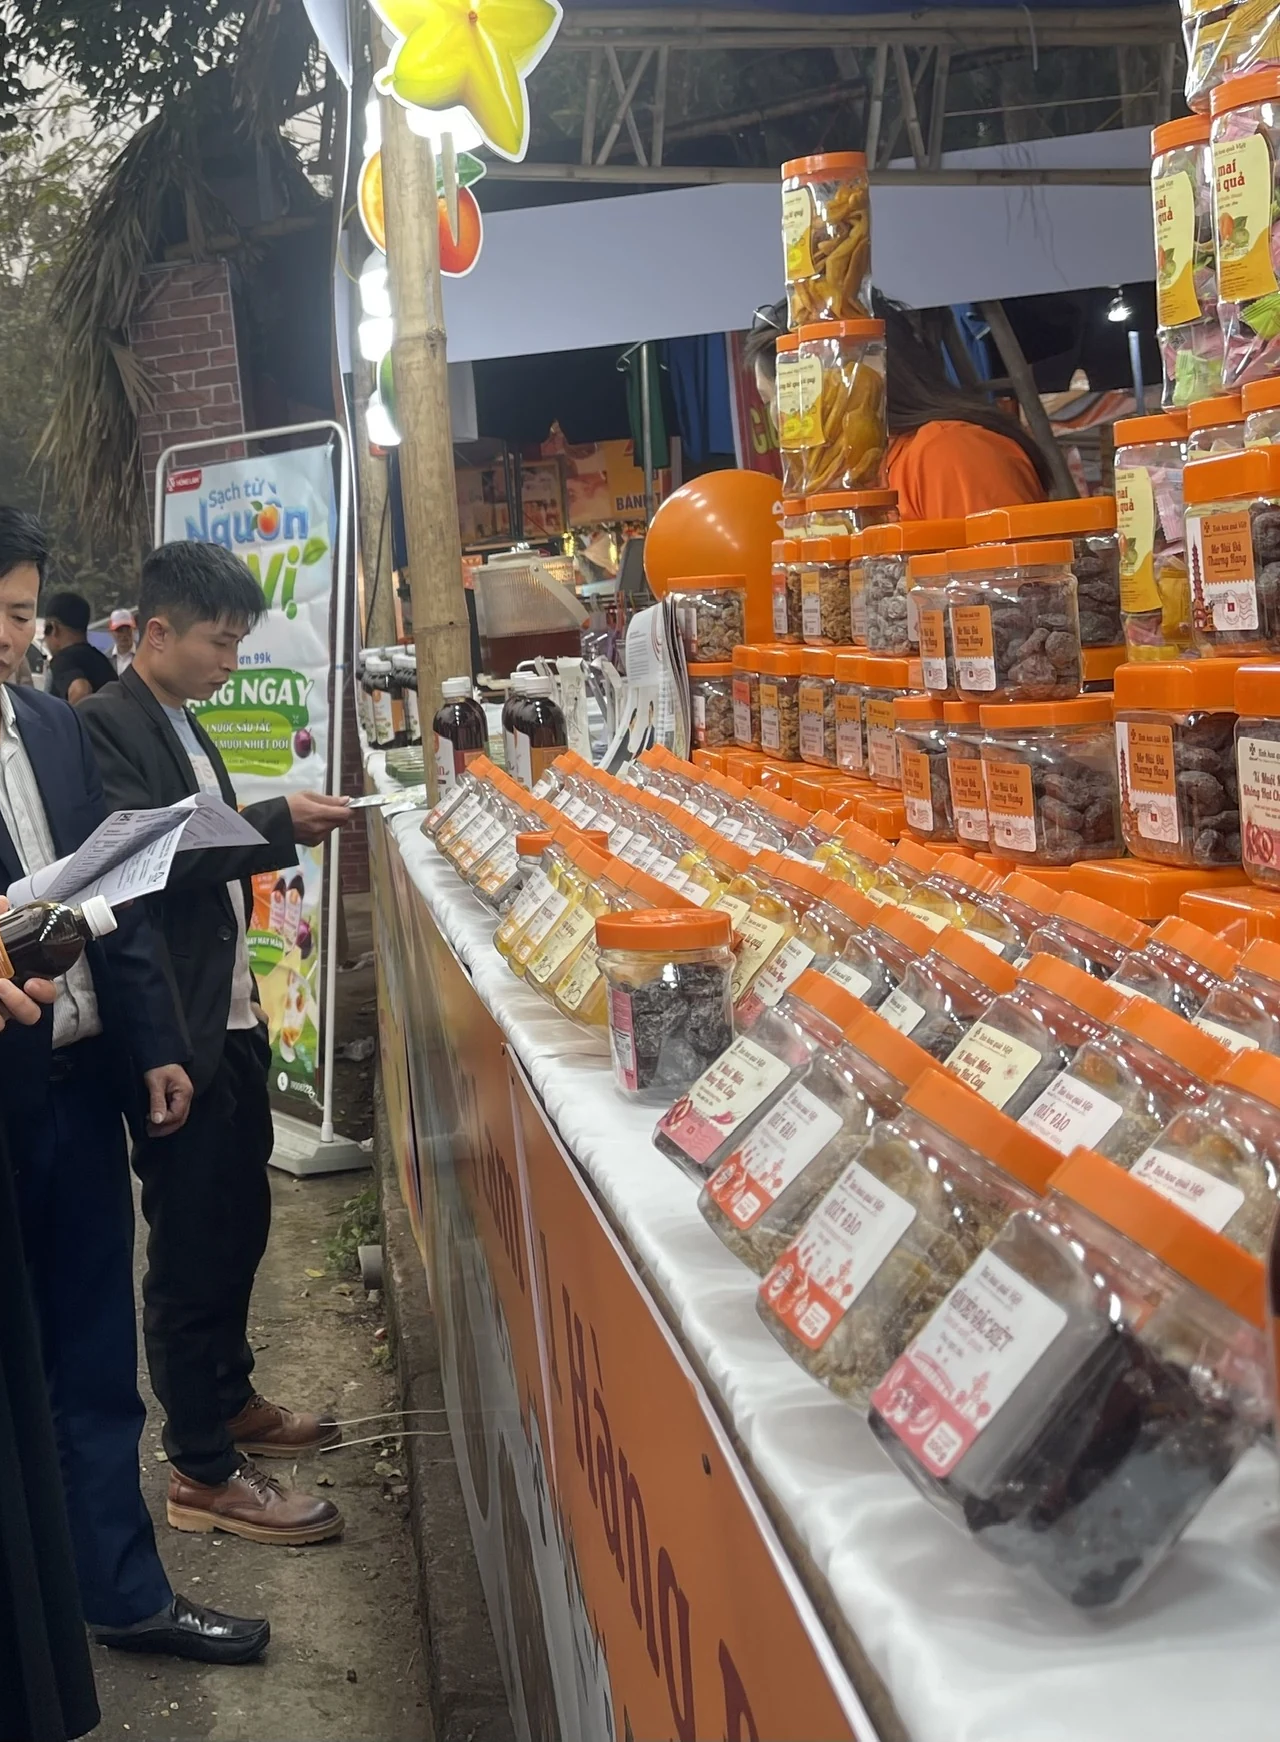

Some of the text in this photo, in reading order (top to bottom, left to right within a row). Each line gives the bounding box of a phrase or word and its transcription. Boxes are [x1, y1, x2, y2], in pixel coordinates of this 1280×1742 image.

[1223, 171, 1245, 193] quả
[208, 478, 265, 510] Sạch từ
[239, 651, 271, 665] ơn 99k
[240, 677, 315, 707] NGAY
[1002, 1044, 1013, 1054] Việt
[970, 1074, 986, 1092] Cay
[1081, 1100, 1093, 1112] Việt
[1049, 1112, 1071, 1132] ĐÀO
[1189, 1183, 1205, 1196] Việt
[840, 1212, 862, 1236] ĐÀO
[562, 1282, 697, 1742] Hàng
